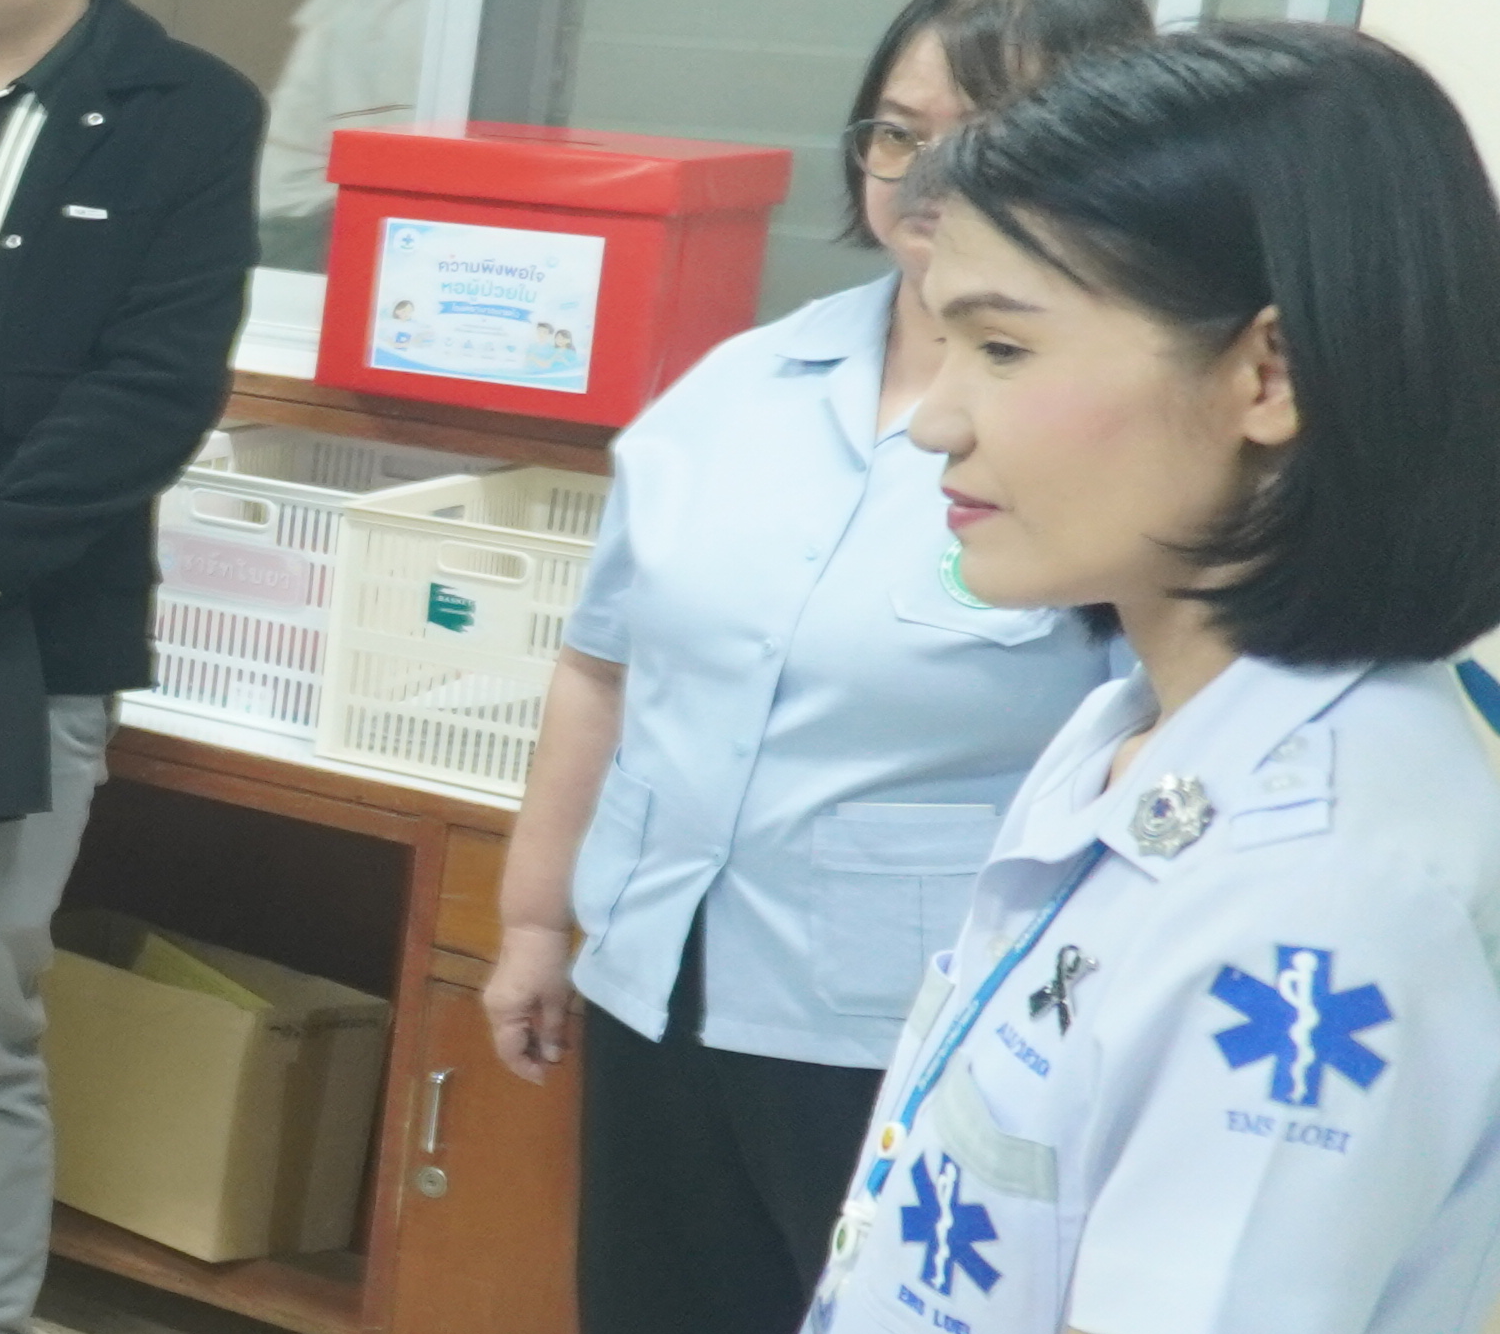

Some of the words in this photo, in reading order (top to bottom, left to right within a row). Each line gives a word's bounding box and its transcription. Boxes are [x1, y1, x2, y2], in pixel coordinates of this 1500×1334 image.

[438, 257, 545, 283] ความพึงพอใจ
